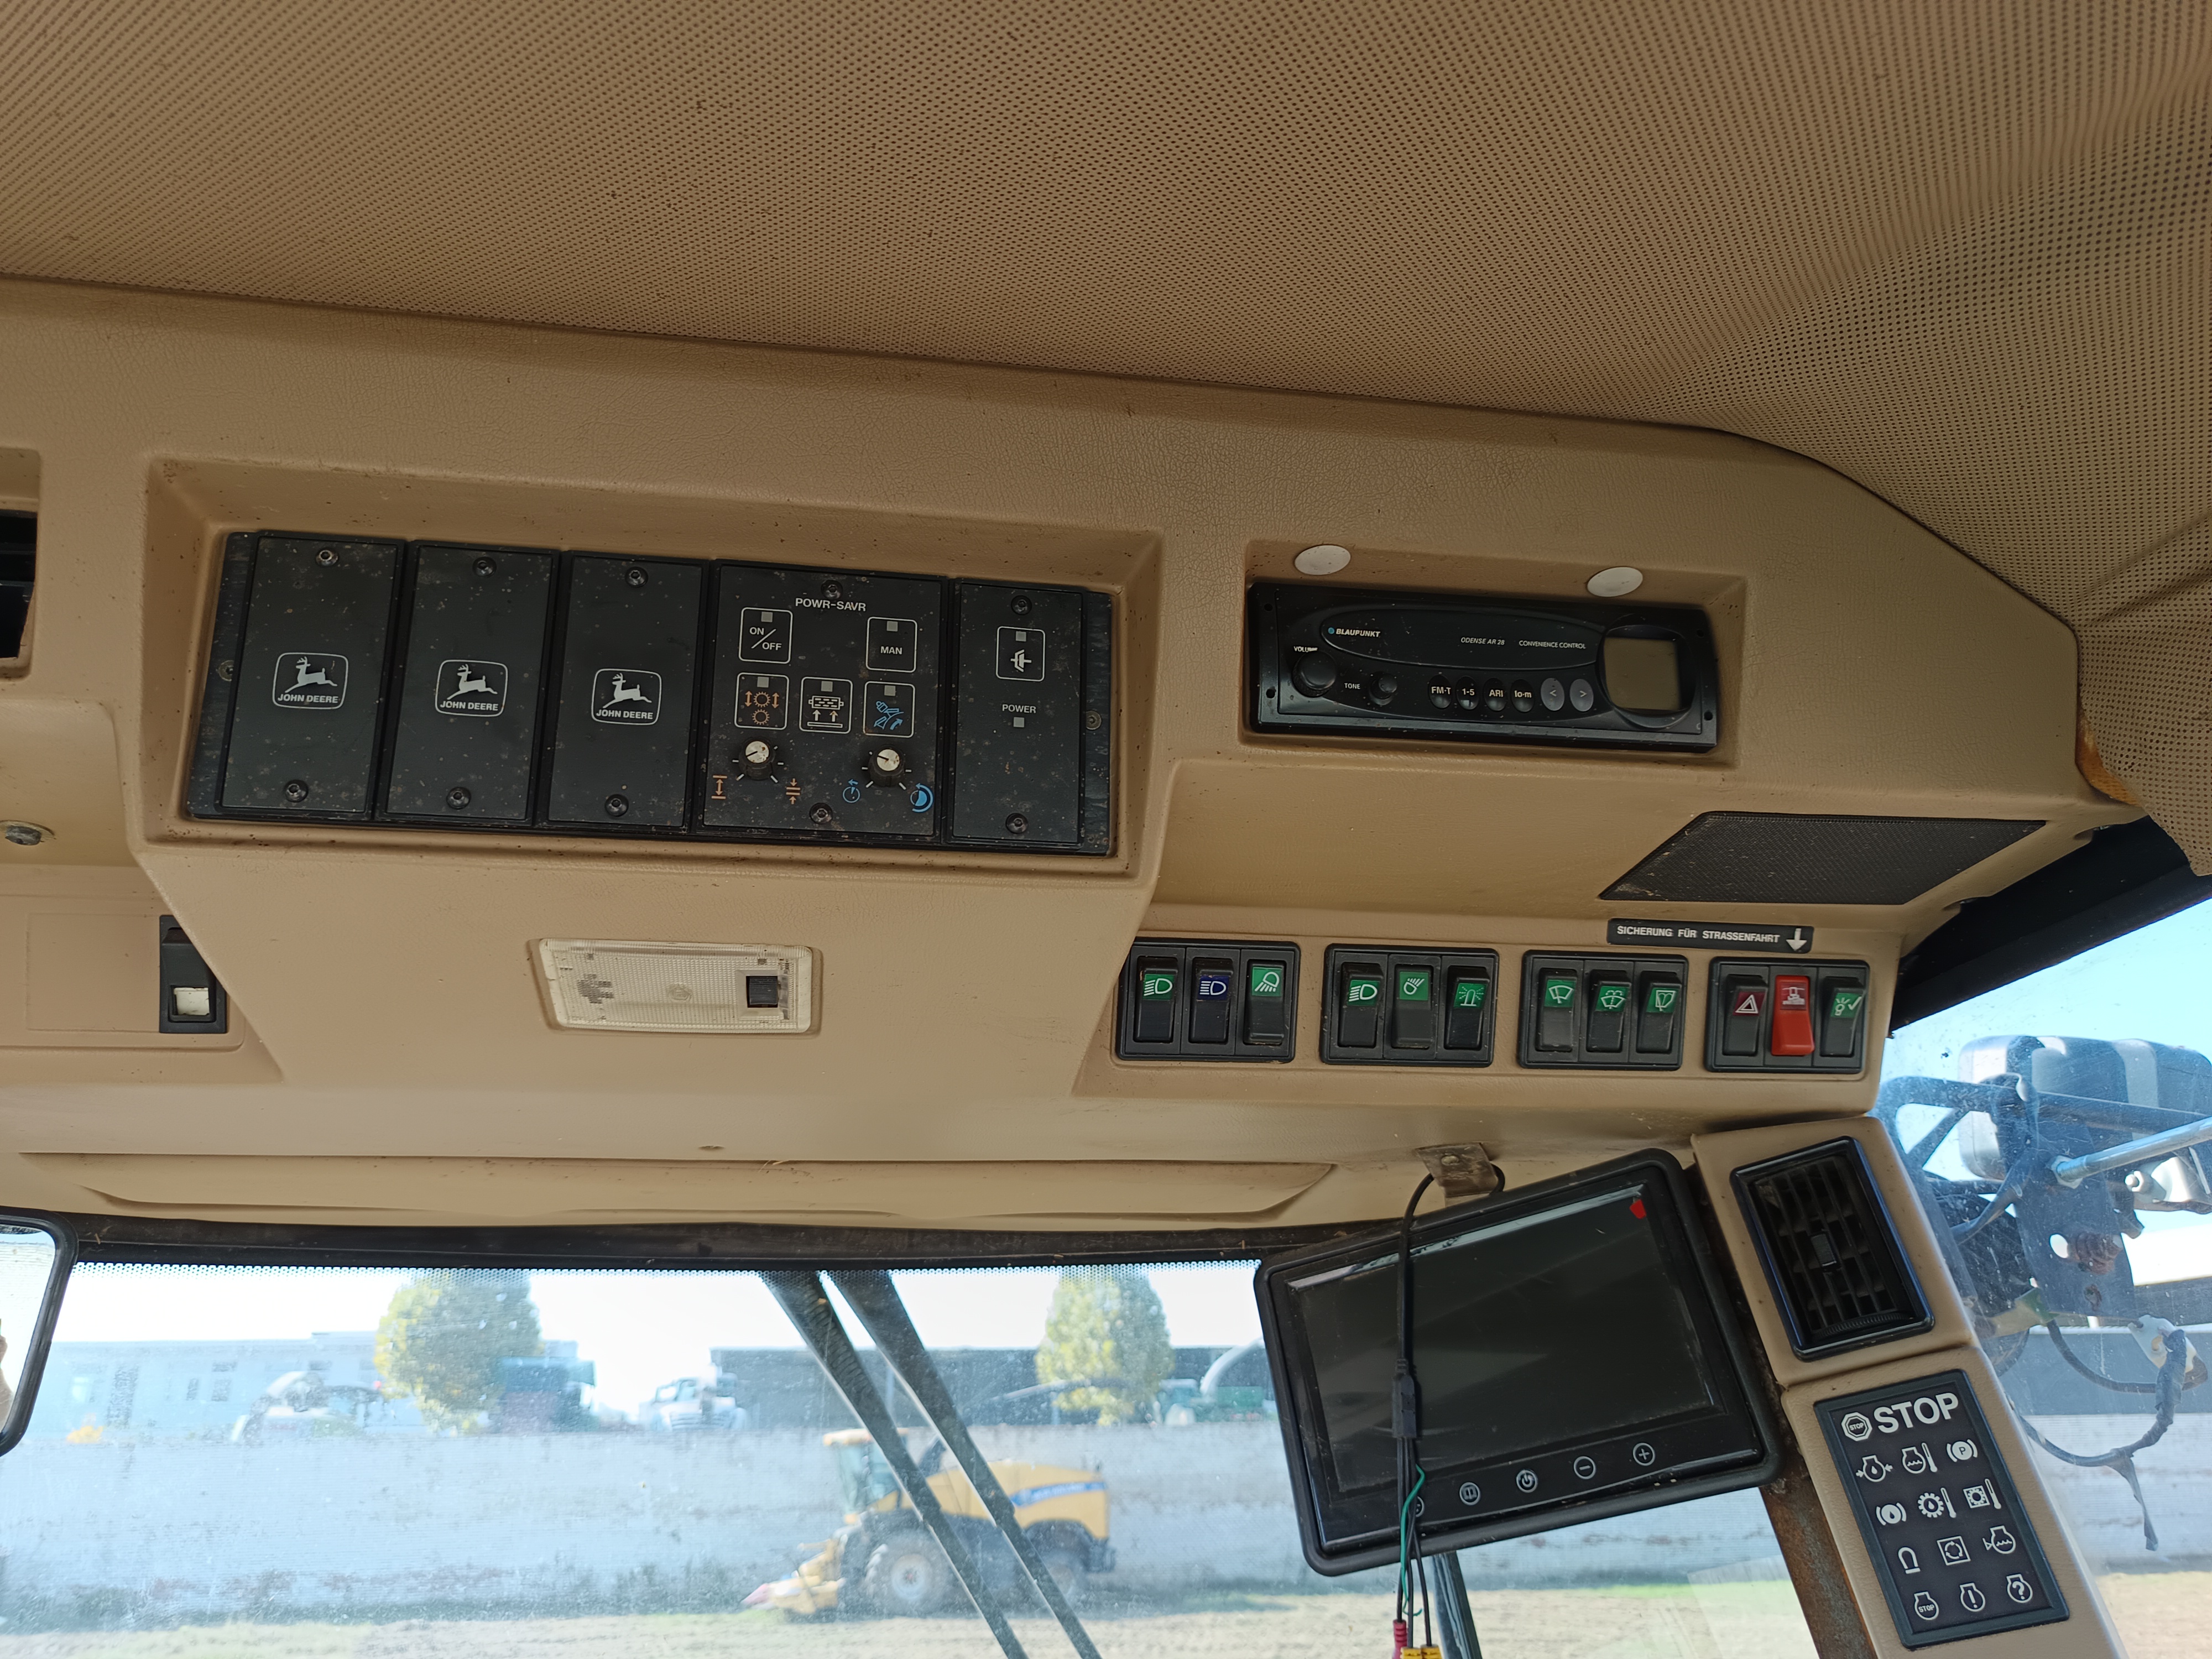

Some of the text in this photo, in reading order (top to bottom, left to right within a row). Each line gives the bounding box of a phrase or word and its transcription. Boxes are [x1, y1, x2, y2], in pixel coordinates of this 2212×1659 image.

[795, 597, 867, 612] POWR-SAVR
[749, 627, 764, 635] ON
[1335, 628, 1381, 638] BLAUPUNKT
[761, 642, 782, 651] OFF
[1519, 640, 1558, 648] CONVENIENCE
[880, 646, 902, 655] MAN
[278, 693, 338, 703] JOHN DEERE
[440, 701, 498, 711] JOHN DEERE
[1002, 704, 1036, 713] POWER
[596, 709, 654, 719] JOHN DEERE
[1617, 925, 1780, 943] SICHERUNG FÜR STRASSENFAHRT
[1874, 1392, 1959, 1433] STOP
[1849, 1422, 1864, 1431] STOP
[1918, 1604, 1935, 1613] STOP
